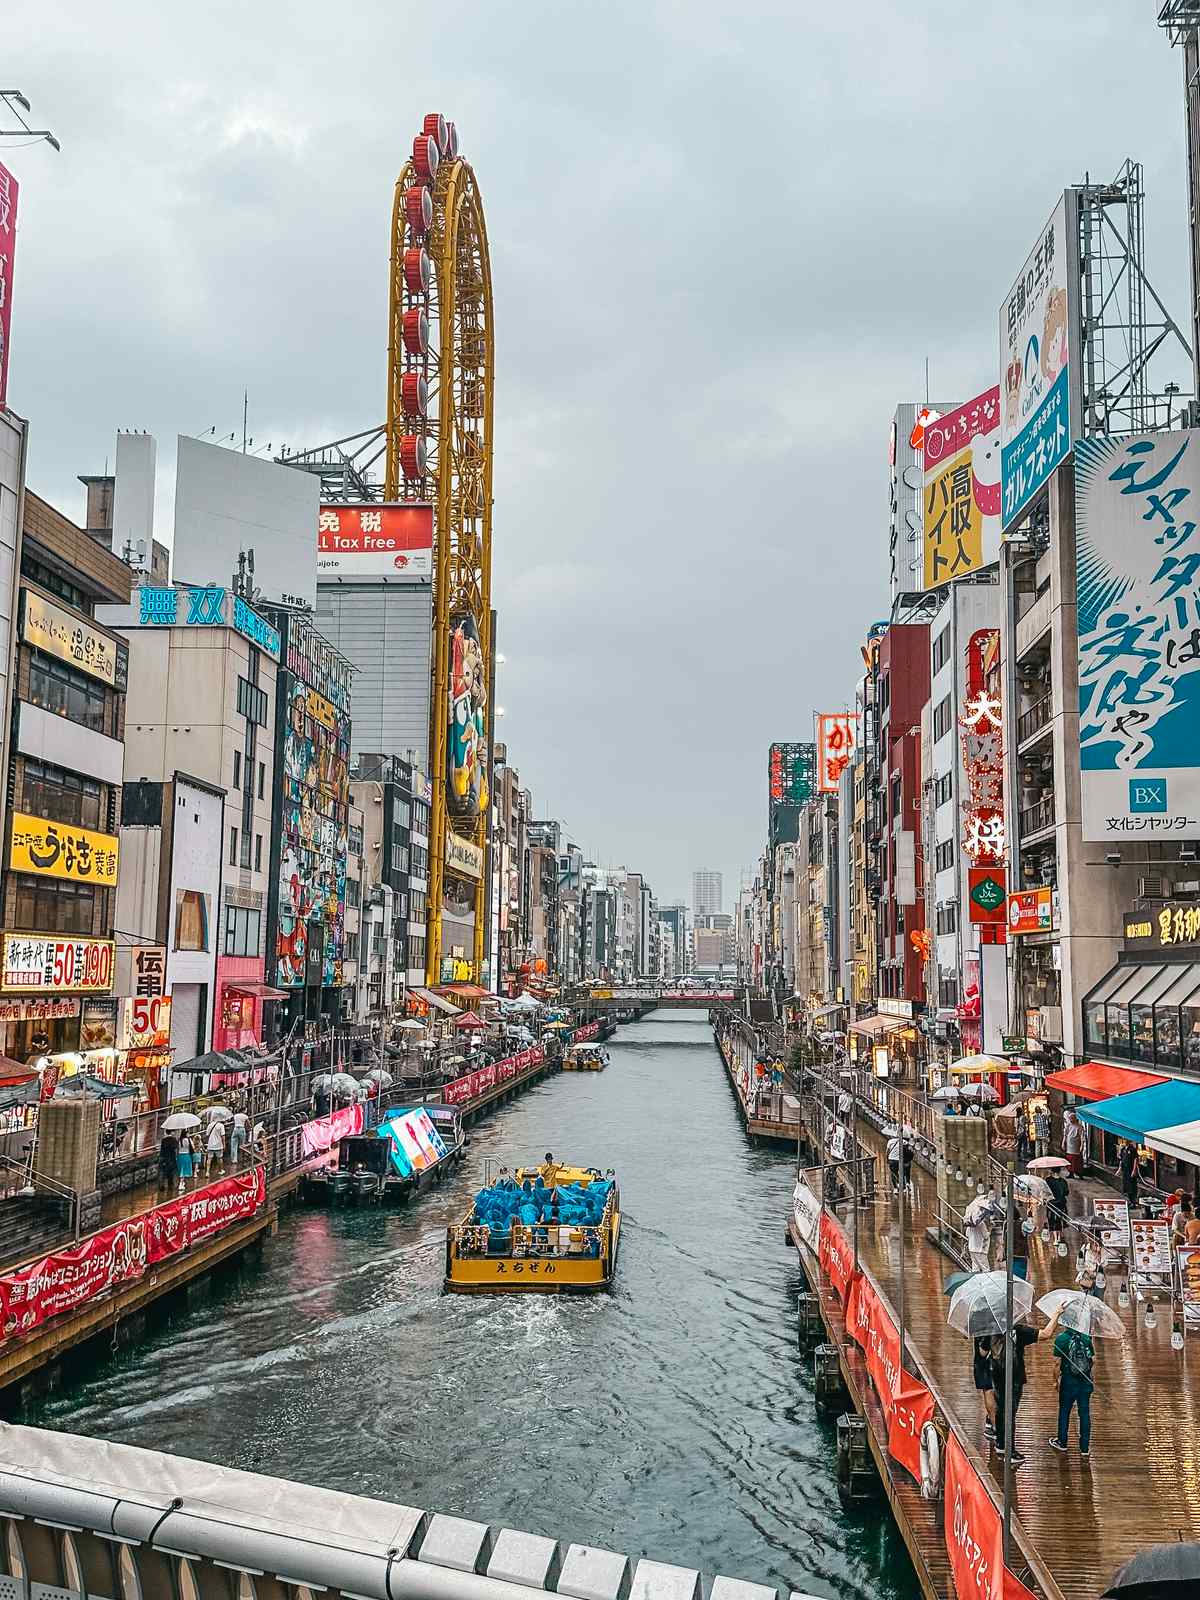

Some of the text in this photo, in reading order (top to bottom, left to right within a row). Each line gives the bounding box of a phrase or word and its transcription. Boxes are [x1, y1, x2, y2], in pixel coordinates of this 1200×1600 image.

[1007, 224, 1055, 333] 店舗の王様
[944, 398, 1000, 441] いちごな
[1005, 414, 1066, 515] ガルフネット
[928, 475, 951, 581] バイト
[950, 462, 972, 573] 高収入
[333, 536, 359, 549] Tax
[364, 536, 396, 549] Free
[139, 587, 225, 624] 無双
[1135, 788, 1162, 804] BX
[29, 826, 93, 875] うなぎ
[979, 888, 997, 899] حلال
[9, 940, 44, 970] 新時代
[44, 943, 54, 986] 伝串
[53, 943, 75, 986] 50
[81, 944, 110, 986] 190
[136, 951, 163, 997] 伝串
[131, 998, 161, 1033] 50
[496, 1262, 556, 1273] えちぜん
